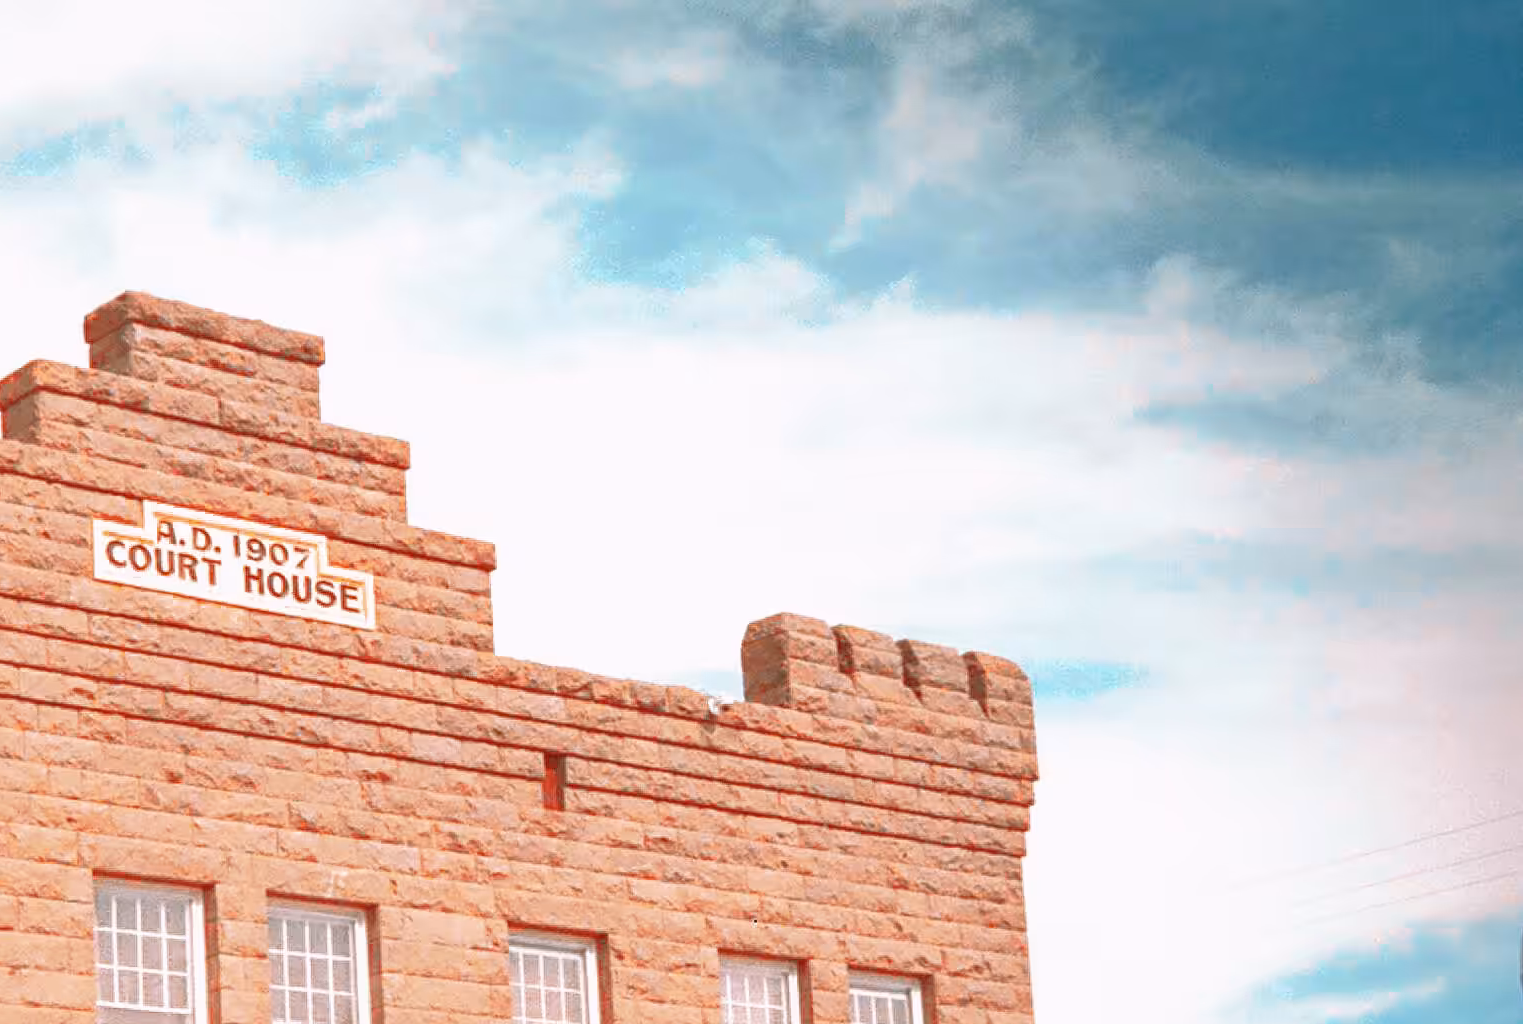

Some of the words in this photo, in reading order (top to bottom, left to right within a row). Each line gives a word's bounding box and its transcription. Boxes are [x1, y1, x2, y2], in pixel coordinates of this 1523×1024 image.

[156, 520, 222, 553] A.D.
[233, 535, 310, 569] 1907
[105, 540, 222, 586] COURT
[243, 565, 361, 613] HOUSE
